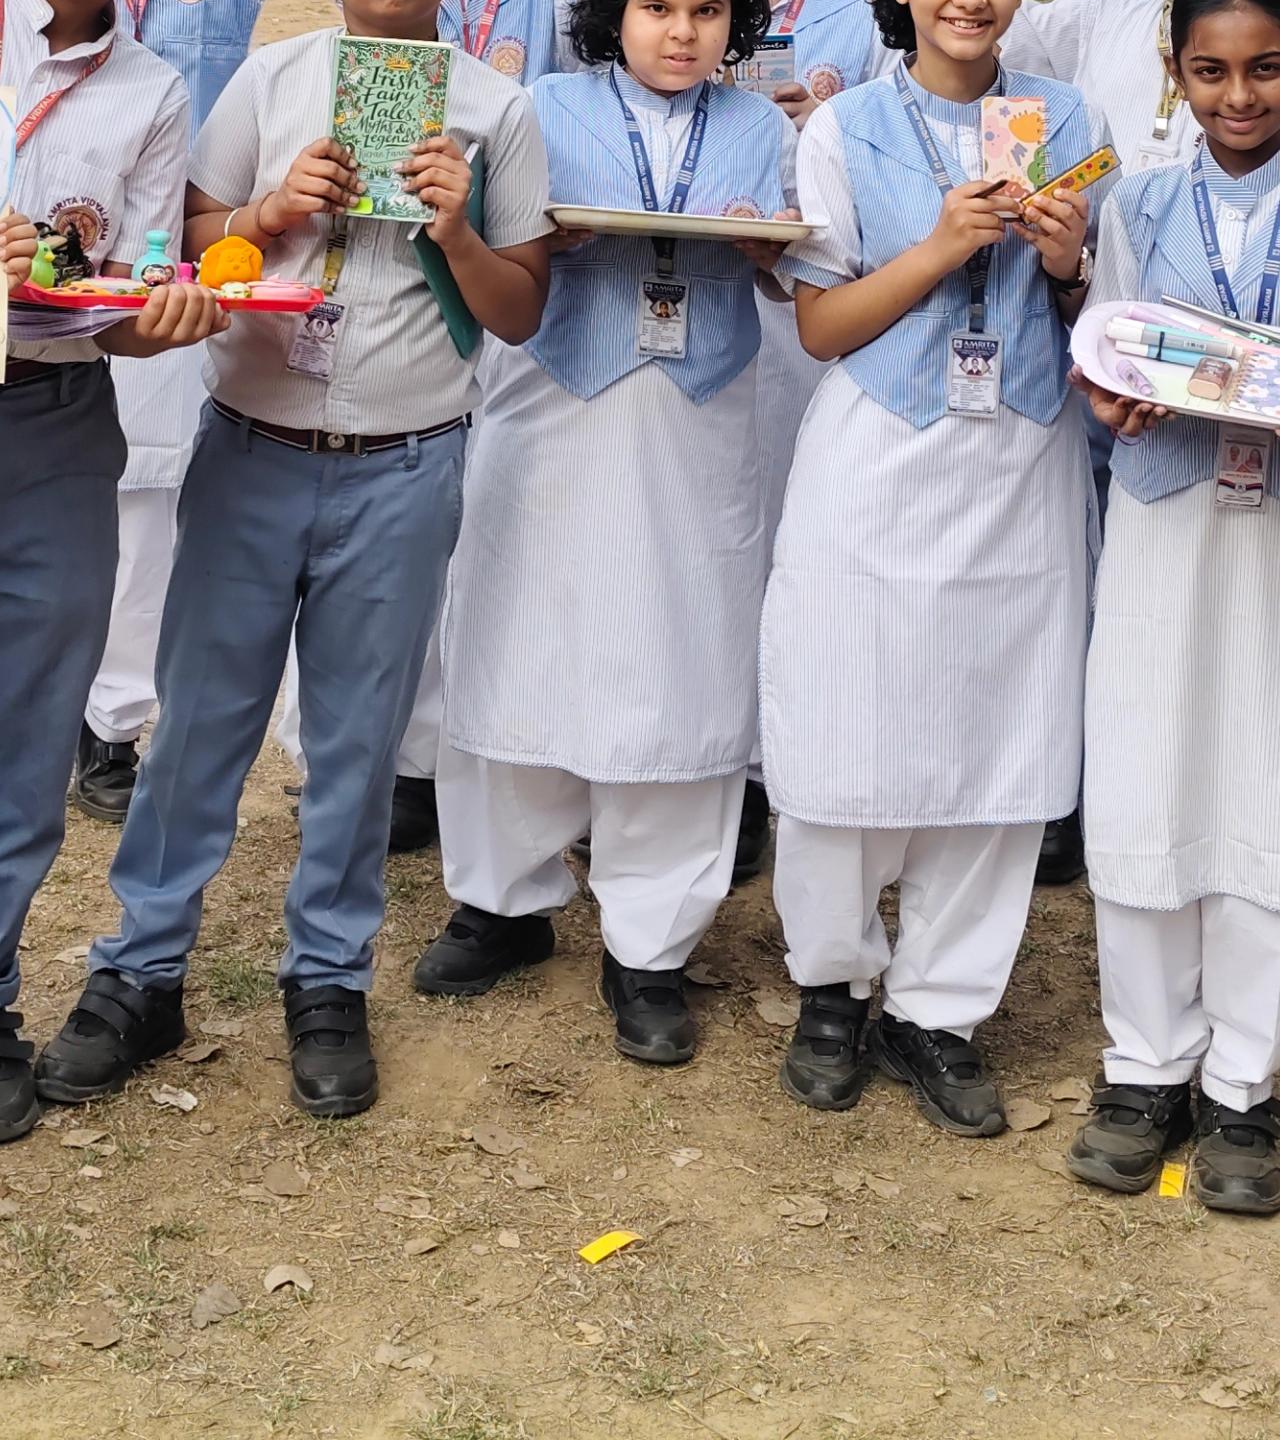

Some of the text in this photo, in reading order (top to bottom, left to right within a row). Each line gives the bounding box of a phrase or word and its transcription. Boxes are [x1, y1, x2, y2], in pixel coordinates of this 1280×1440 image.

[365, 65, 422, 90] Irish
[360, 85, 419, 108] Fairy
[354, 115, 404, 134] Myths &
[363, 128, 417, 151] Legends
[47, 196, 112, 241] AMRITA VIDYALAYAM
[964, 339, 996, 348] AMRITA
